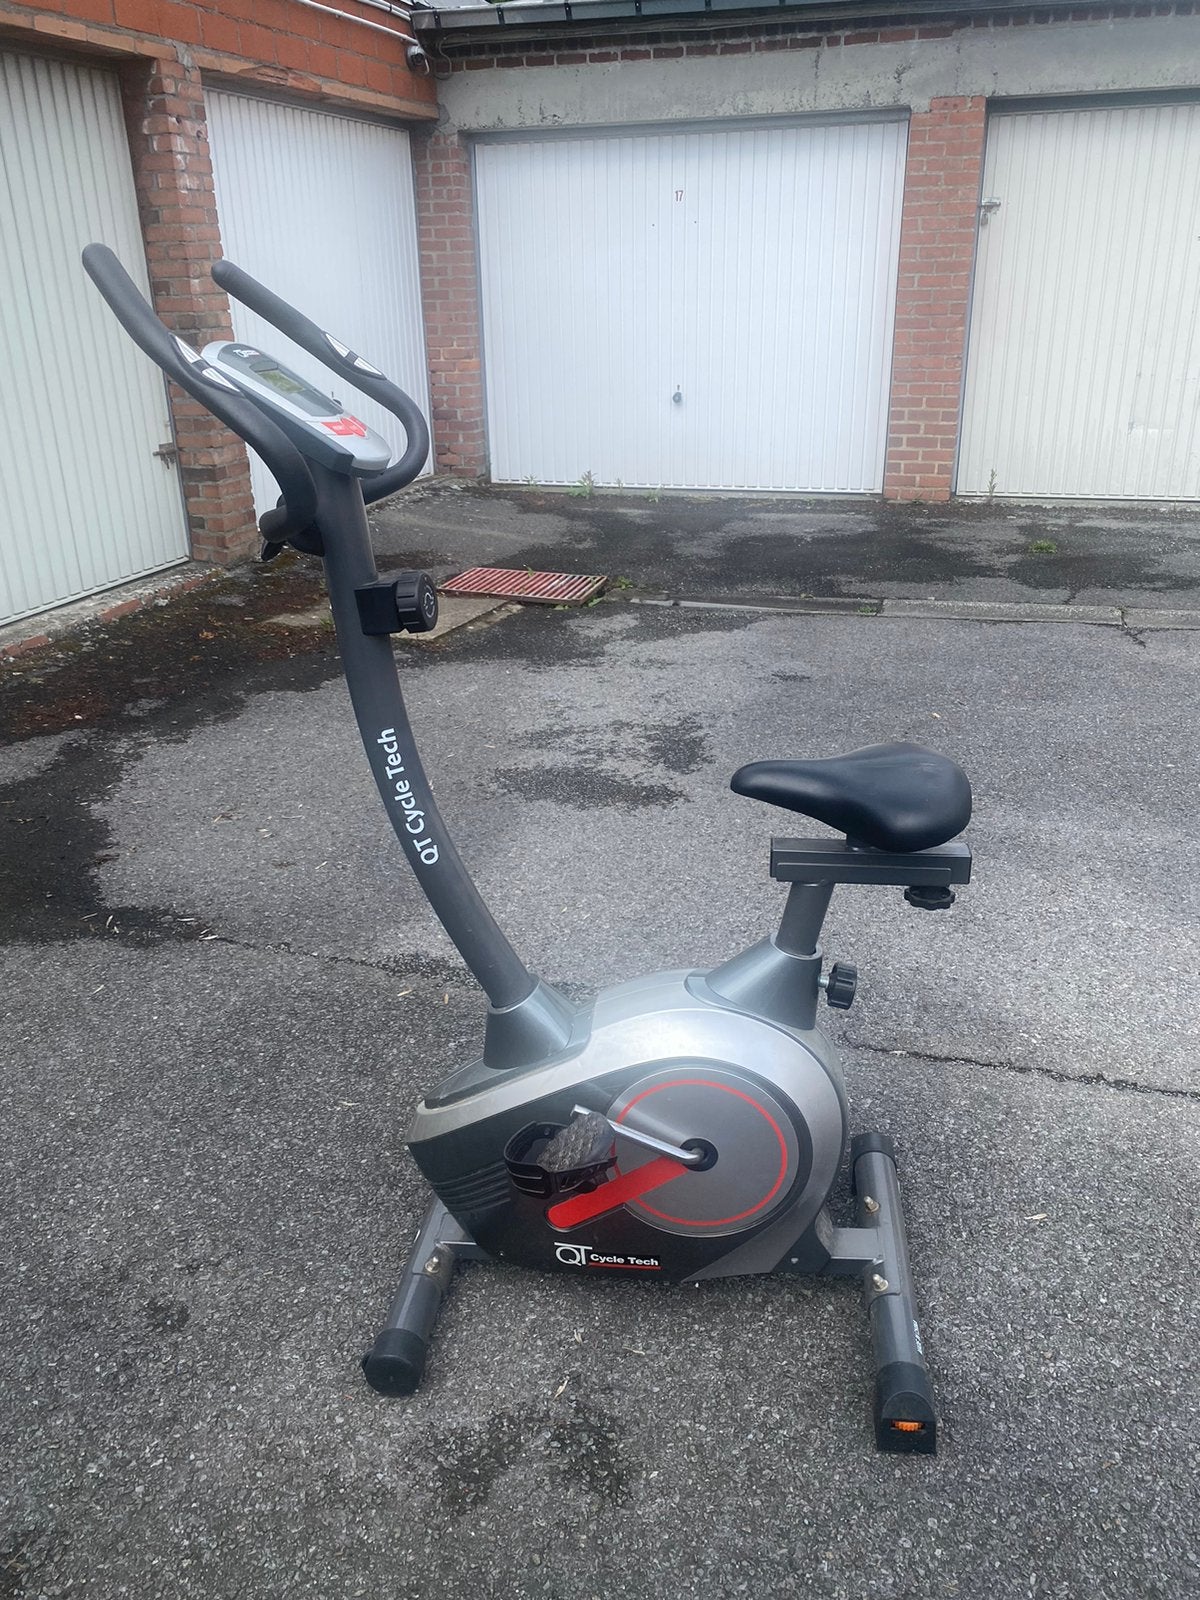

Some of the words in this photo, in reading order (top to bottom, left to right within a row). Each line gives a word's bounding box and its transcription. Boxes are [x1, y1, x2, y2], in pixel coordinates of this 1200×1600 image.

[675, 190, 684, 202] 17
[377, 727, 405, 780] Tech
[394, 779, 425, 834] Cycle
[413, 837, 439, 865] QT
[554, 1242, 593, 1266] QT
[590, 1253, 625, 1264] Cycle
[627, 1256, 659, 1266] Tech
